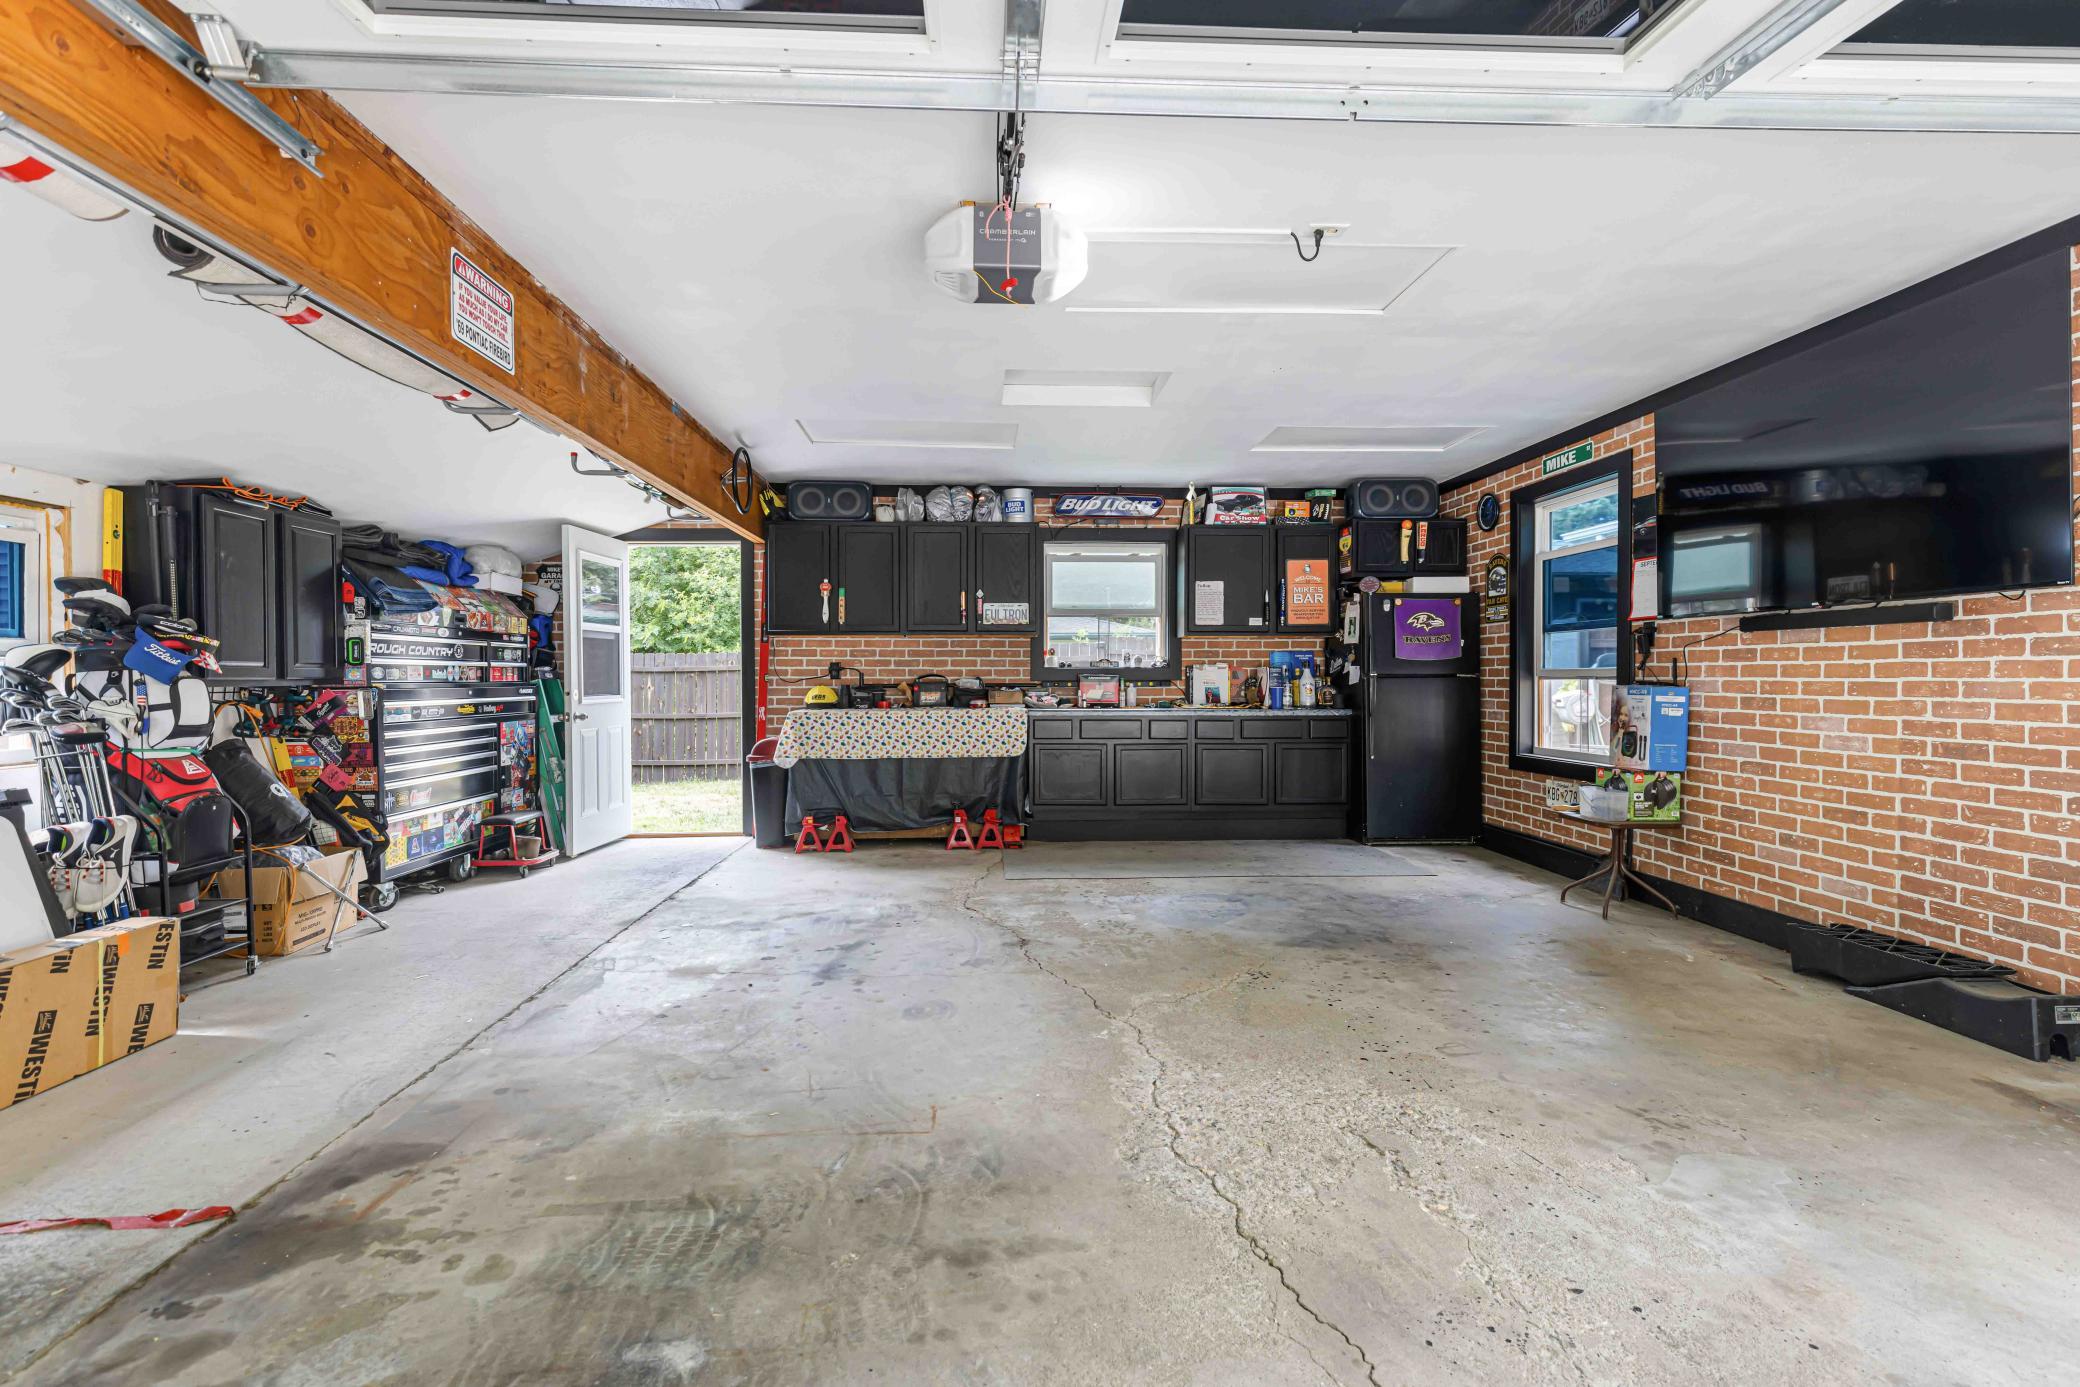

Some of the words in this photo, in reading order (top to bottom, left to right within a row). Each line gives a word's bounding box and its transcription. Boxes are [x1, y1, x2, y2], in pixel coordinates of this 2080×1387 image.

[464, 264, 509, 310] WARNING
[458, 281, 464, 292] IF
[463, 285, 473, 299] YOU
[473, 291, 487, 309] VALUE
[487, 301, 498, 317] YOUR
[458, 291, 465, 304] AS
[465, 296, 478, 313] MUCH
[478, 306, 485, 318] AS
[487, 311, 493, 324] DO
[493, 316, 500, 328] MY
[458, 301, 467, 315] YOU
[482, 317, 496, 335] TOUCH
[465, 323, 489, 351] PONTIAC
[488, 339, 511, 366] FIREBIRD
[1546, 450, 1576, 472] MIKE
[1060, 498, 1101, 512] BUD
[1101, 499, 1159, 512] LIGHT
[1640, 560, 1657, 568] SEPTE
[1294, 575, 1322, 583] WELCOME
[1293, 593, 1324, 604] BAR
[160, 620, 193, 632] cobra
[1403, 634, 1451, 644] RAVENS
[144, 643, 181, 665] Titleist
[370, 643, 407, 654] ROUGH
[408, 645, 453, 657] COUNTRY
[1547, 786, 1560, 801] KBG
